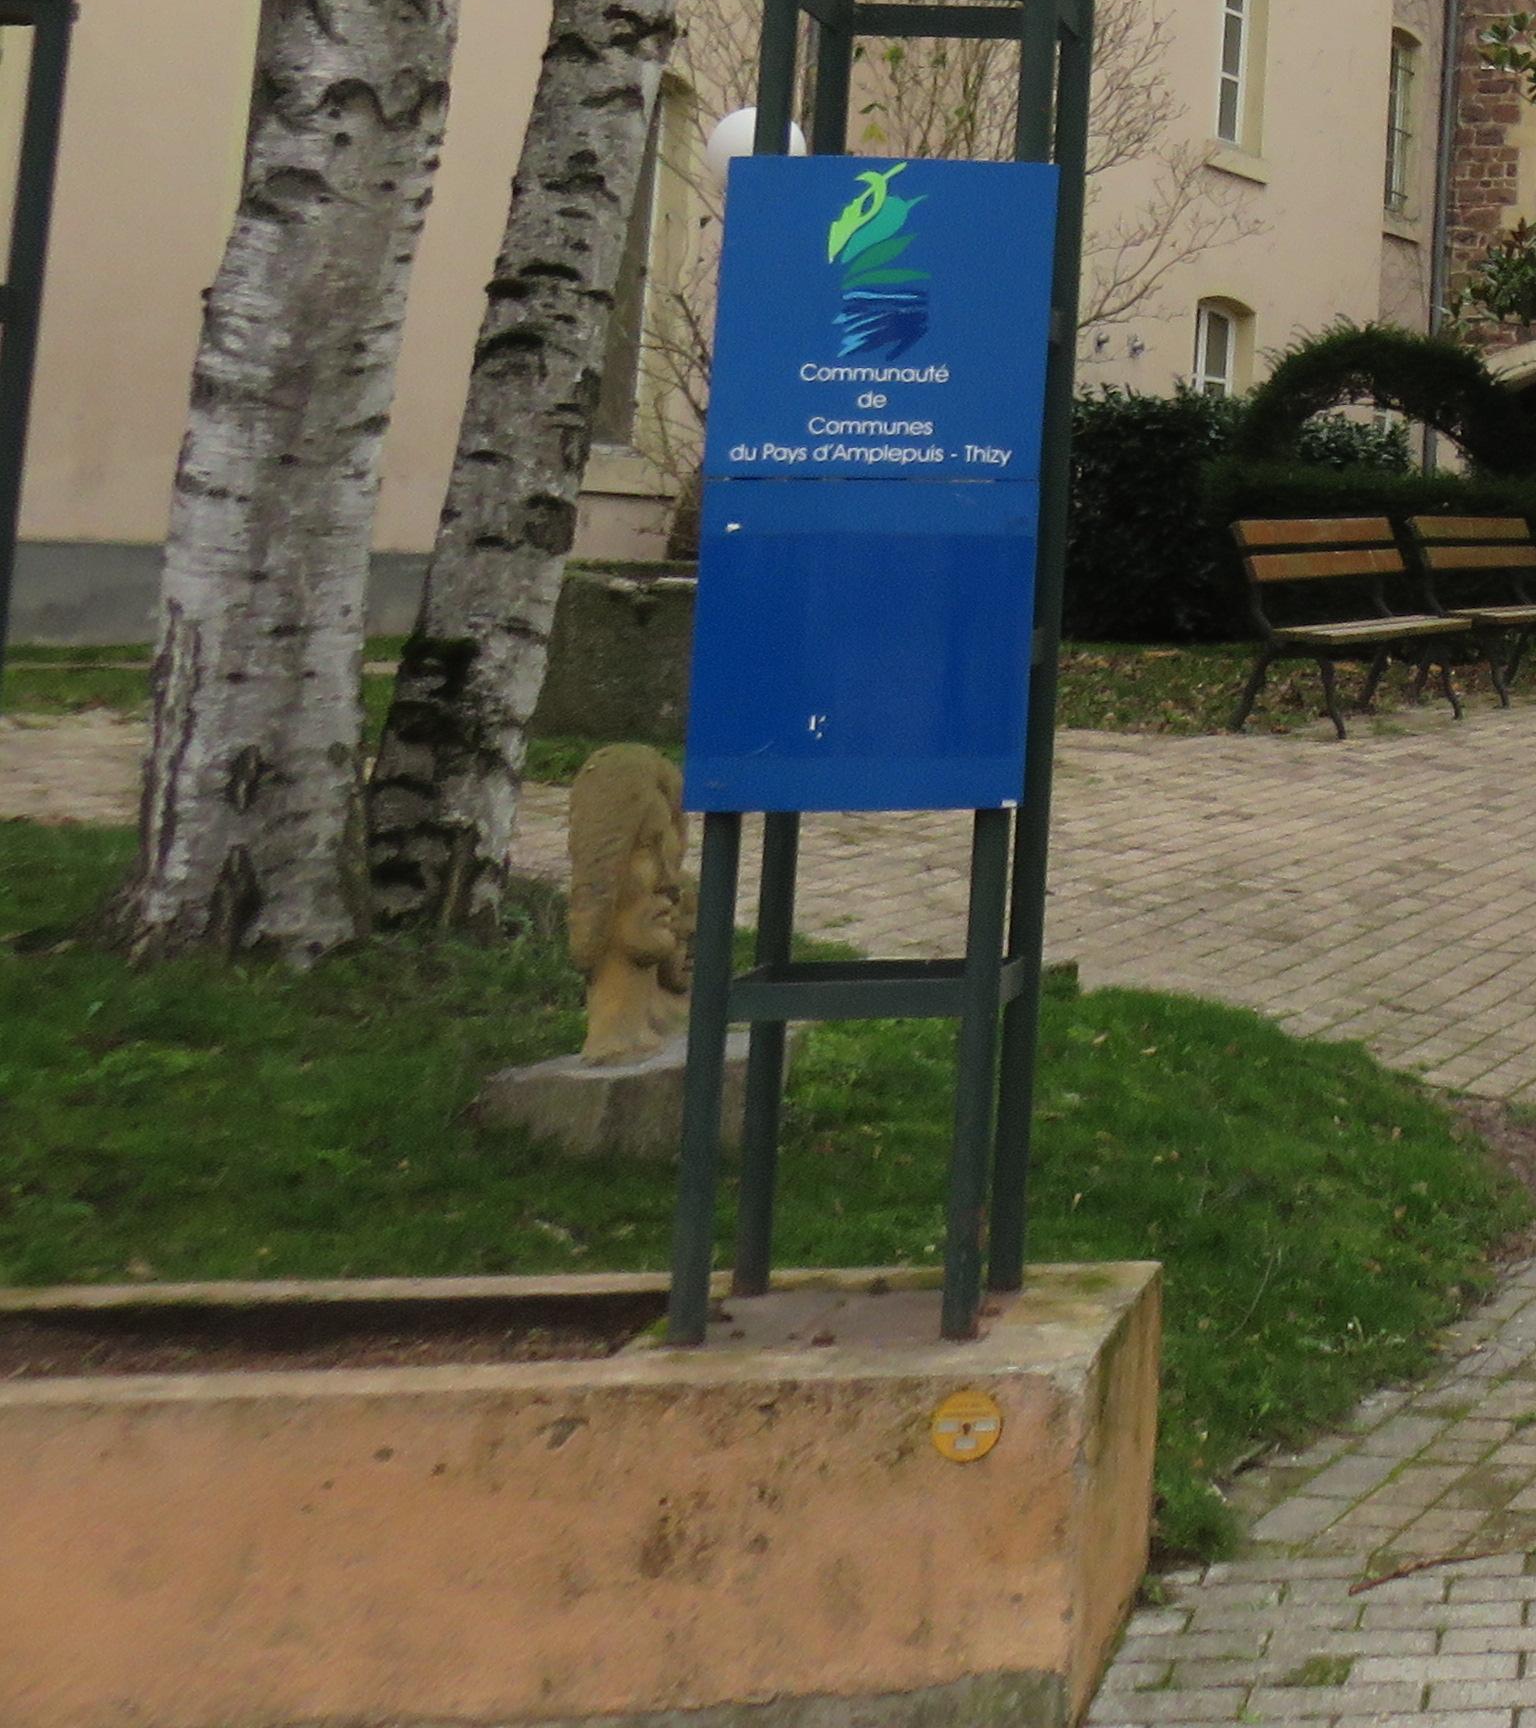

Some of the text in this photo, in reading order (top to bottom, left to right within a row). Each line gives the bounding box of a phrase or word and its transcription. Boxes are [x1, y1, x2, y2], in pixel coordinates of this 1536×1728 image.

[799, 362, 950, 384] Communauté
[857, 390, 887, 410] de
[807, 416, 935, 436] Communes
[729, 444, 757, 462] du
[762, 443, 808, 465] Pays
[812, 443, 944, 466] d'Amplepuis
[964, 443, 1013, 467] Thizy
